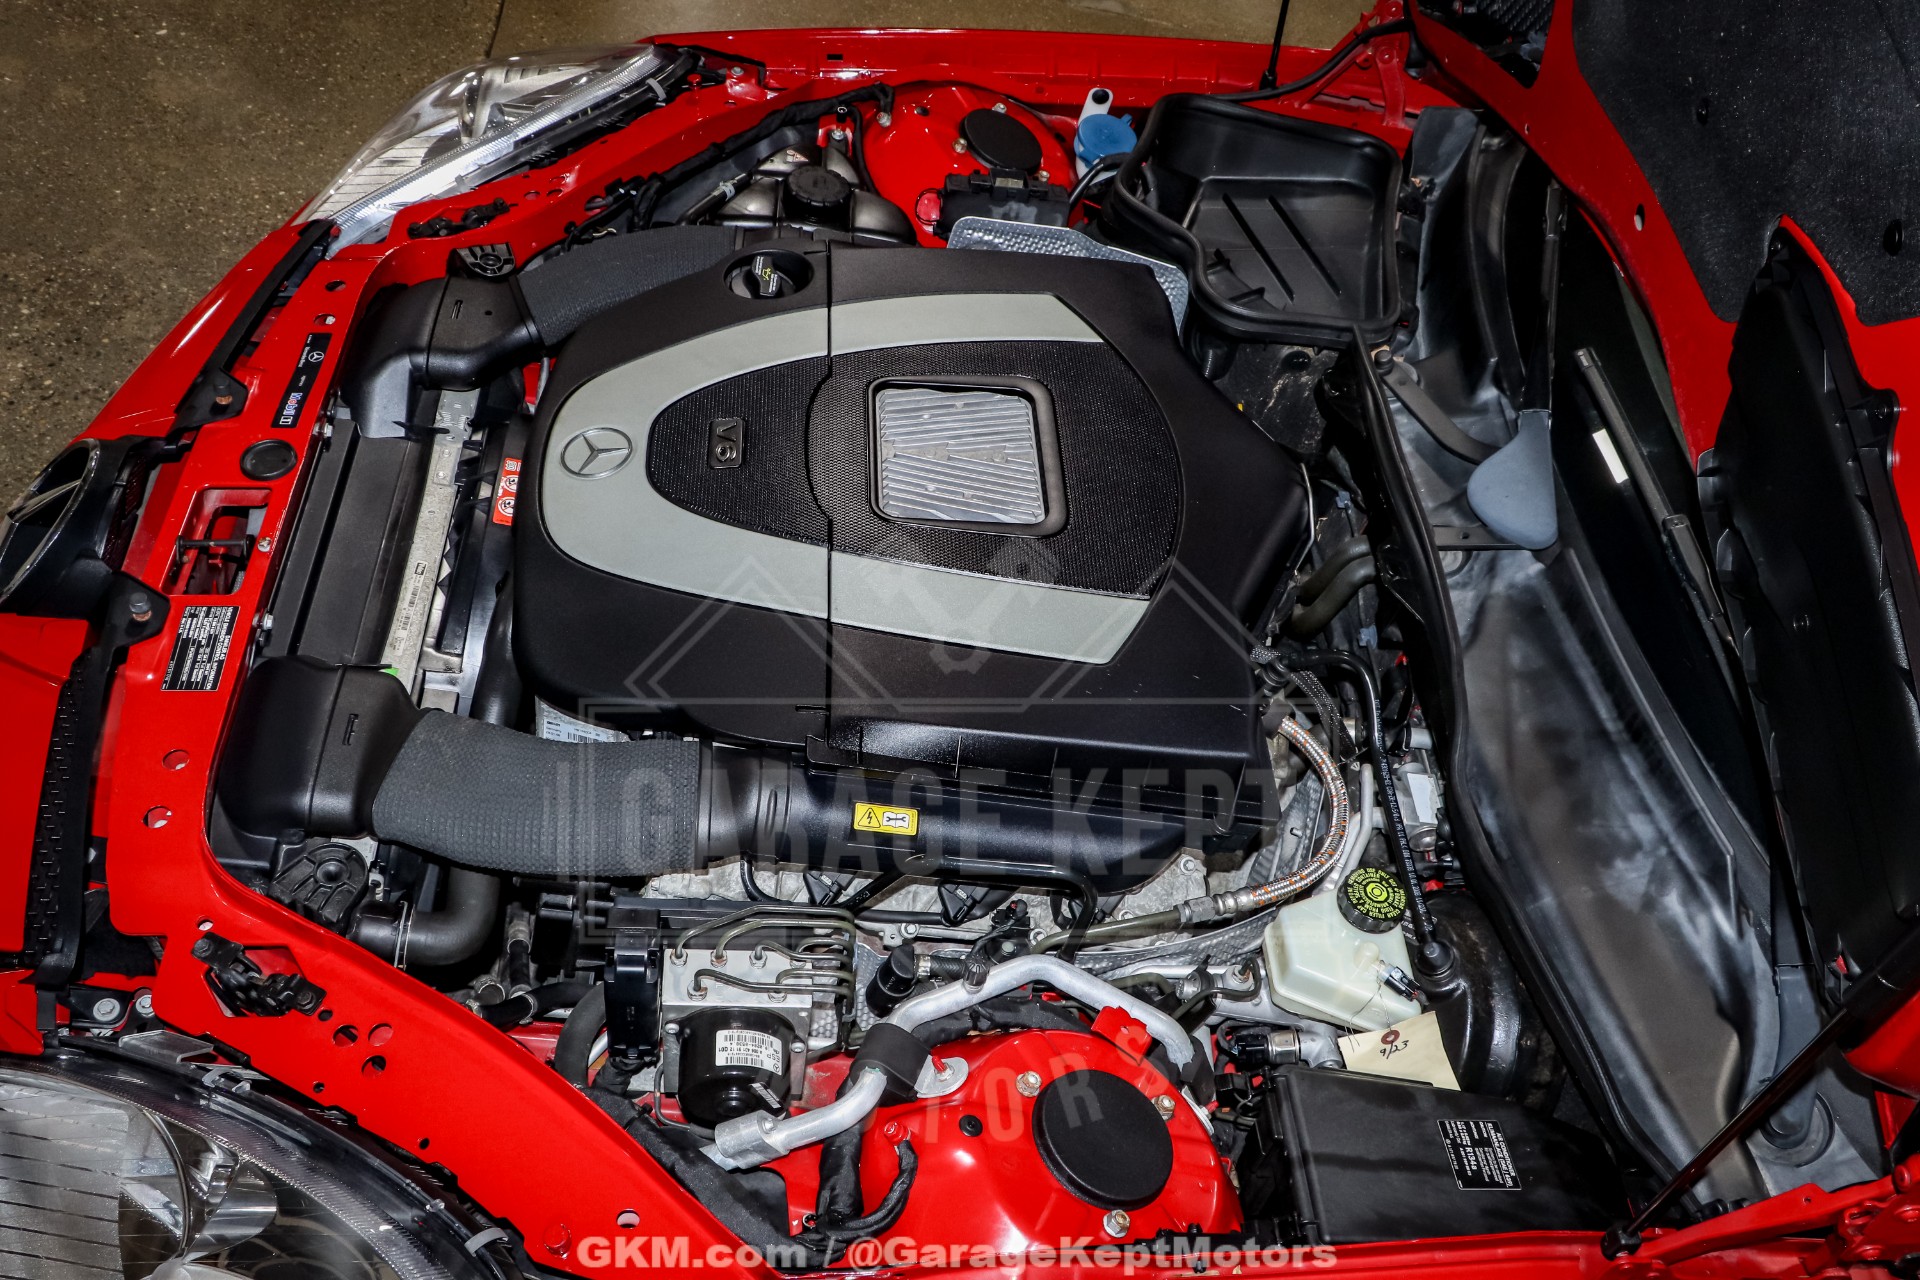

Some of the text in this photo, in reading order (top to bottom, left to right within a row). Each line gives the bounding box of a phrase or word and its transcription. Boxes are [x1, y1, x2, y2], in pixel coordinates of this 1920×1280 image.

[283, 393, 303, 416] Mobil
[715, 421, 737, 463] V6
[213, 643, 223, 661] CONTROL
[205, 662, 218, 690] INFORMATION
[1357, 905, 1367, 913] CAP
[1378, 870, 1390, 879] ONLY
[766, 1053, 779, 1062] ESP
[1378, 1039, 1410, 1060] 9/23
[1465, 1147, 1480, 1170] R134a
[1496, 1133, 1516, 1176] AIR CONDITIONER
